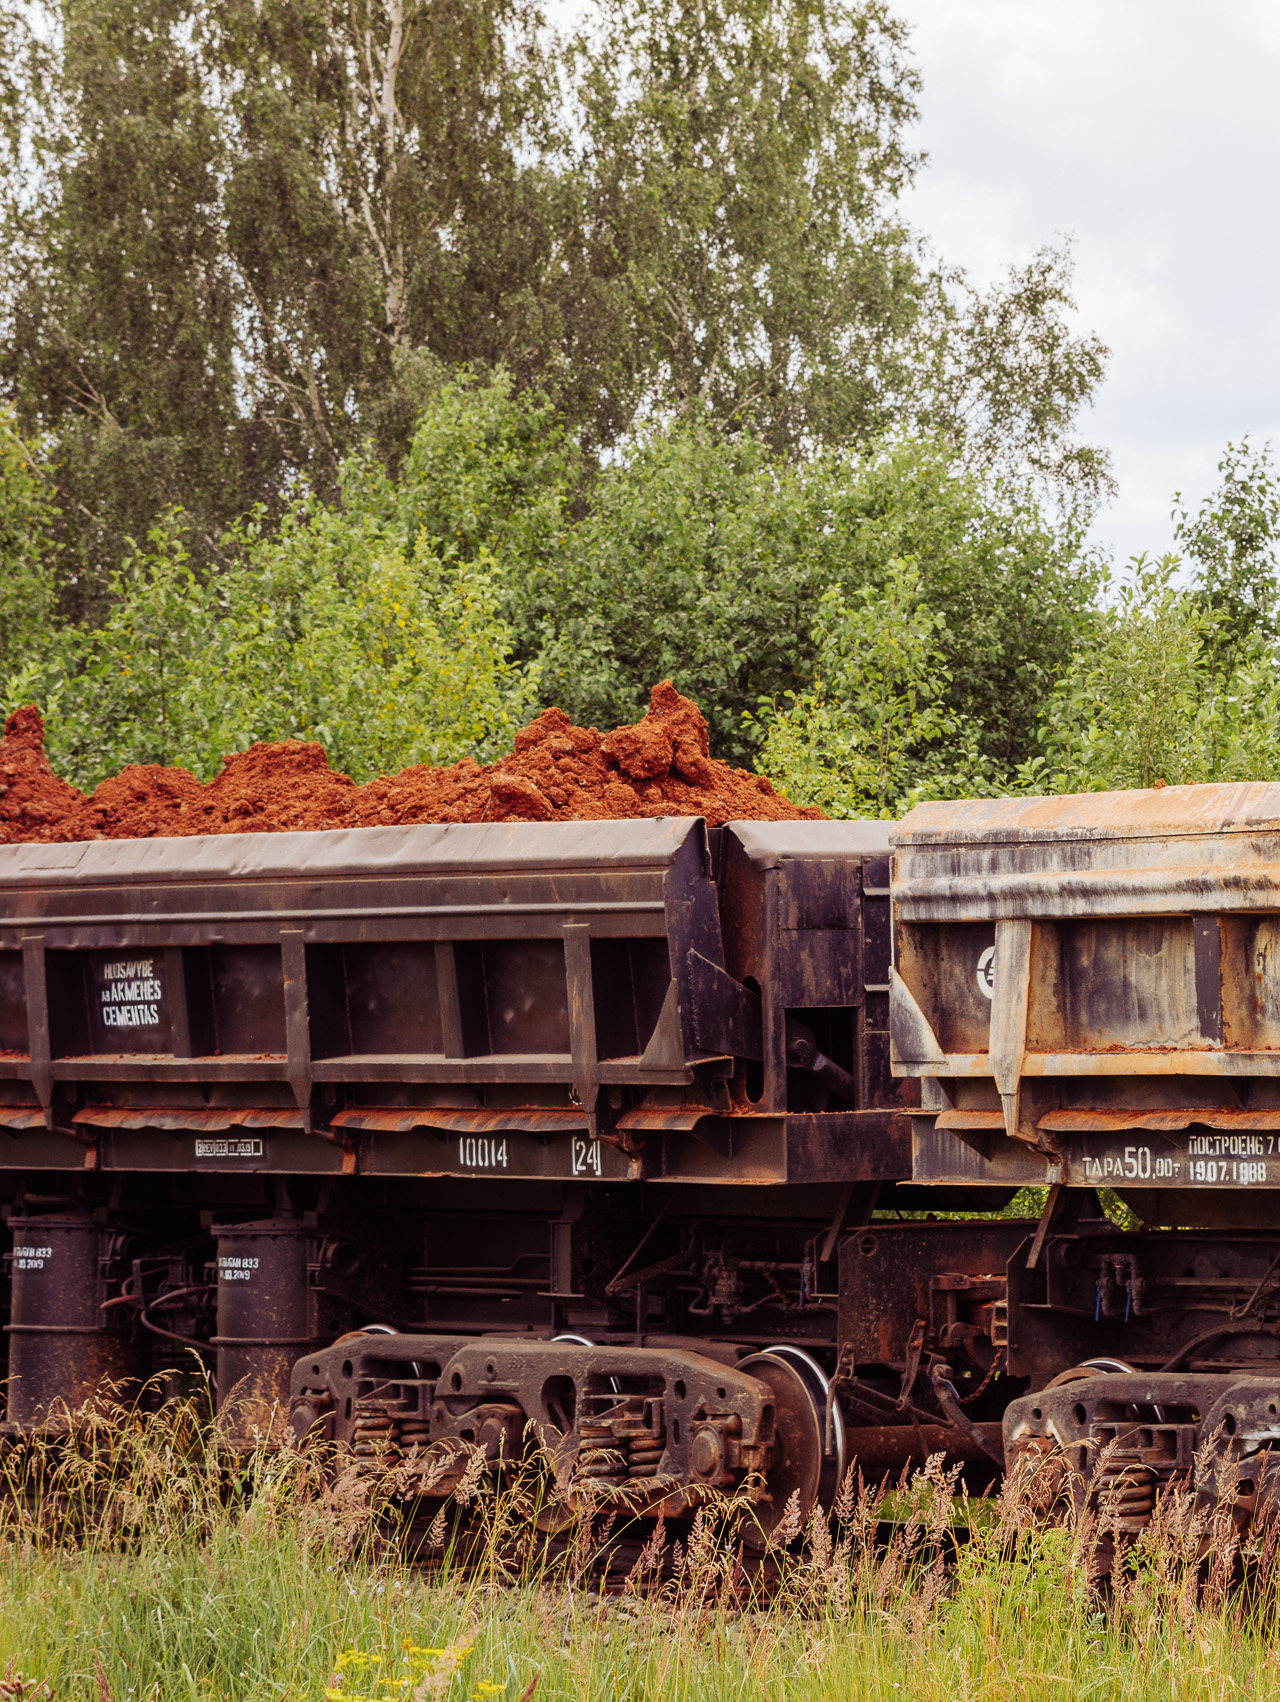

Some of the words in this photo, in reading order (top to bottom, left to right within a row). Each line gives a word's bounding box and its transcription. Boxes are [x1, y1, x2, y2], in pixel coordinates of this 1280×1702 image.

[103, 1004, 160, 1026] CEMENTAS
[459, 1137, 508, 1168] 10014
[1082, 1157, 1124, 1178] ТАРА
[242, 1258, 259, 1269] 833
